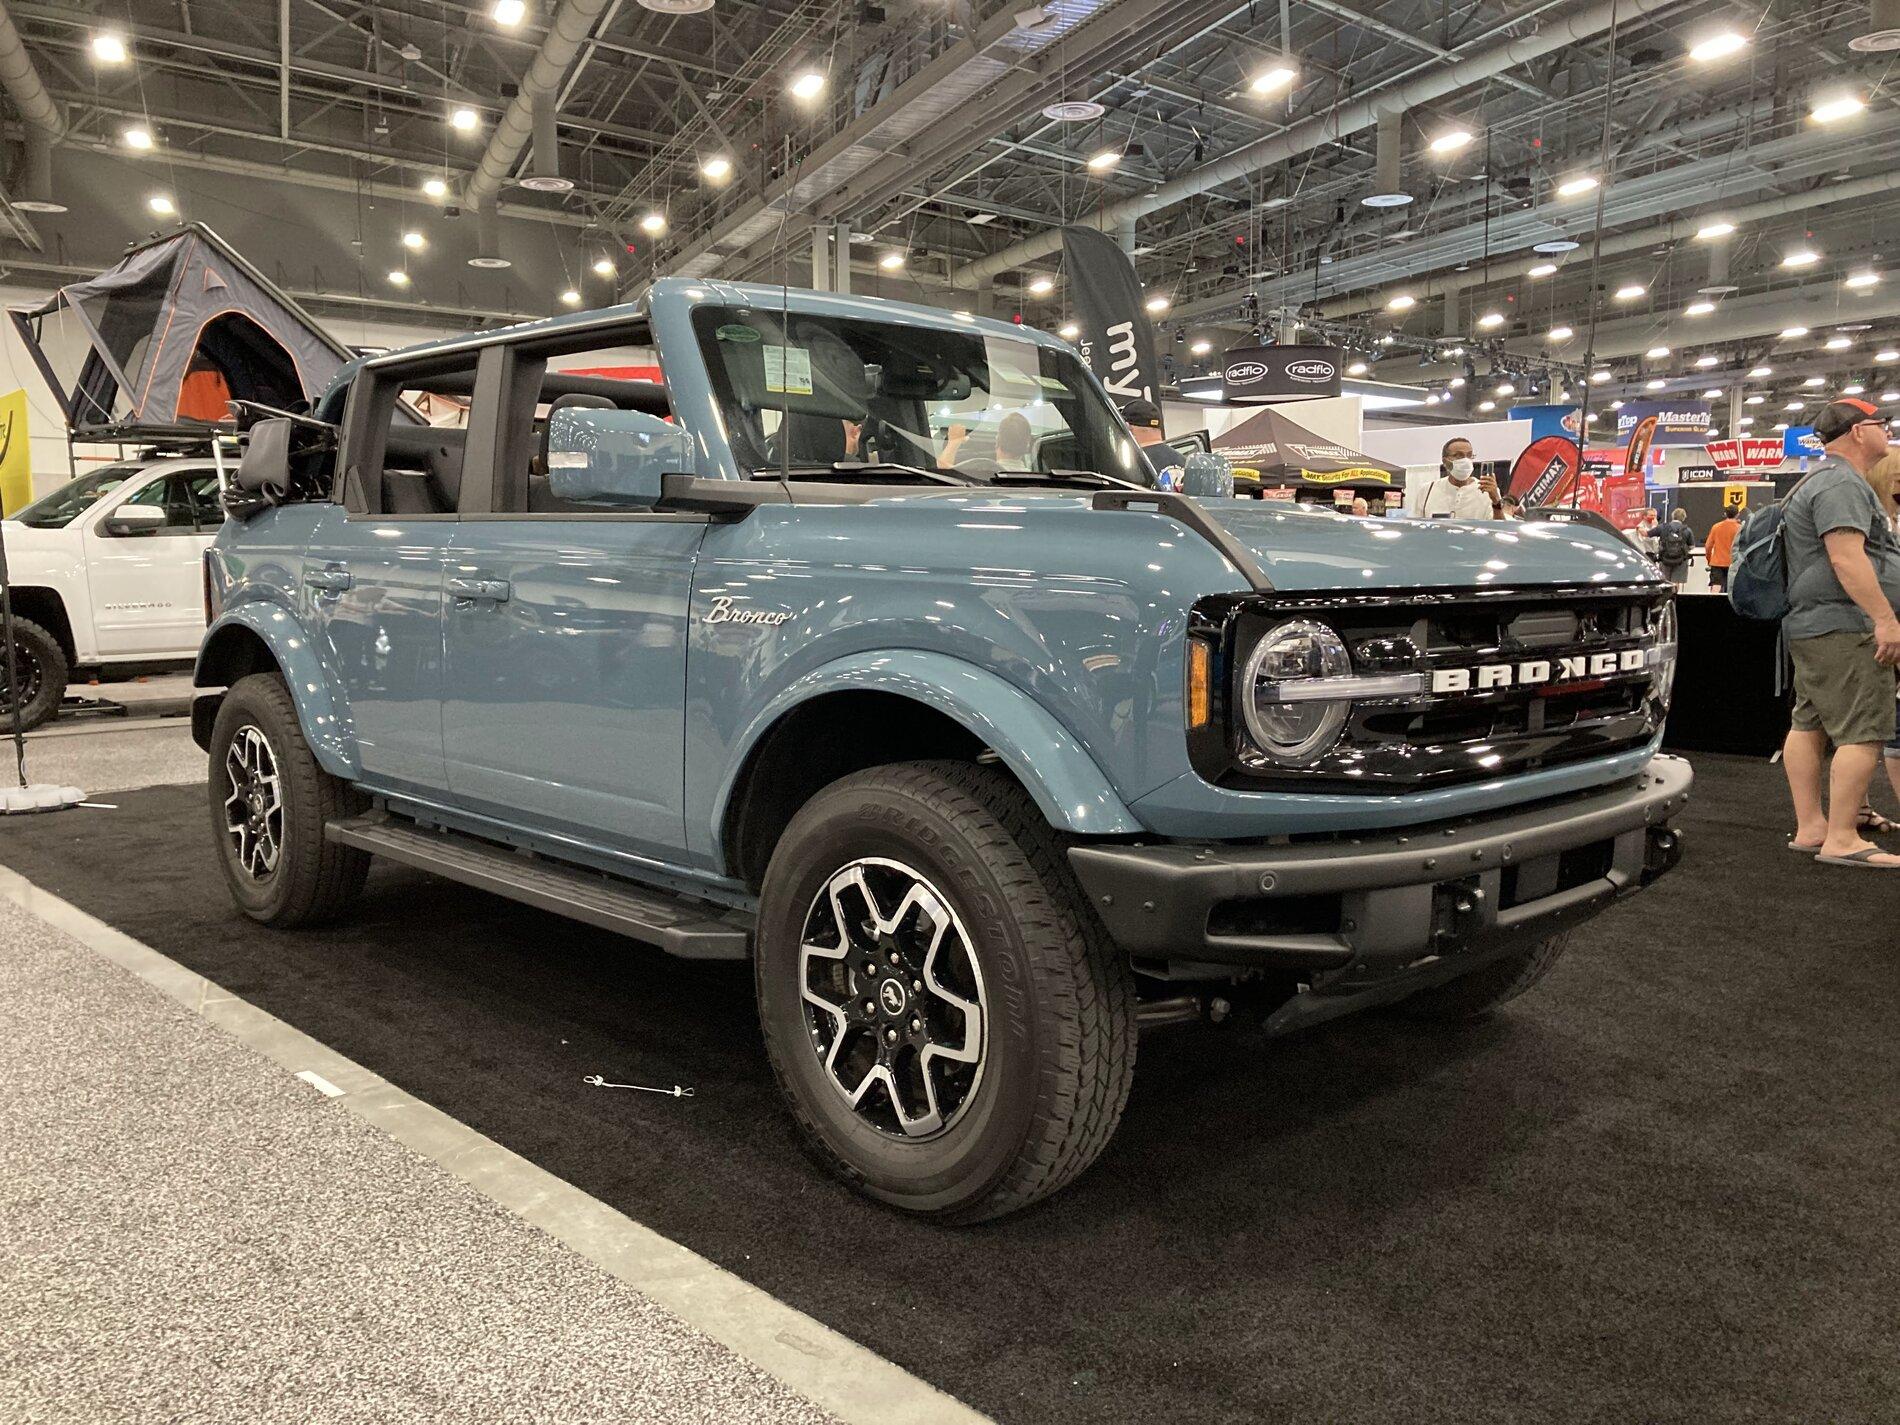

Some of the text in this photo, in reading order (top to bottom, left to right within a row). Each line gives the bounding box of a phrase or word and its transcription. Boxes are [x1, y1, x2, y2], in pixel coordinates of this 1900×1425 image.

[1080, 338, 1093, 370] Jee
[1103, 321, 1152, 402] my
[1228, 366, 1263, 378] radflo
[1292, 364, 1332, 375] radflo
[1711, 448, 1738, 462] WARN
[1746, 447, 1784, 459] WARN
[1528, 460, 1562, 502] TRIMAX
[1690, 469, 1714, 479] ICON
[702, 595, 793, 626] Bronco
[1432, 649, 1645, 693] BRONCO
